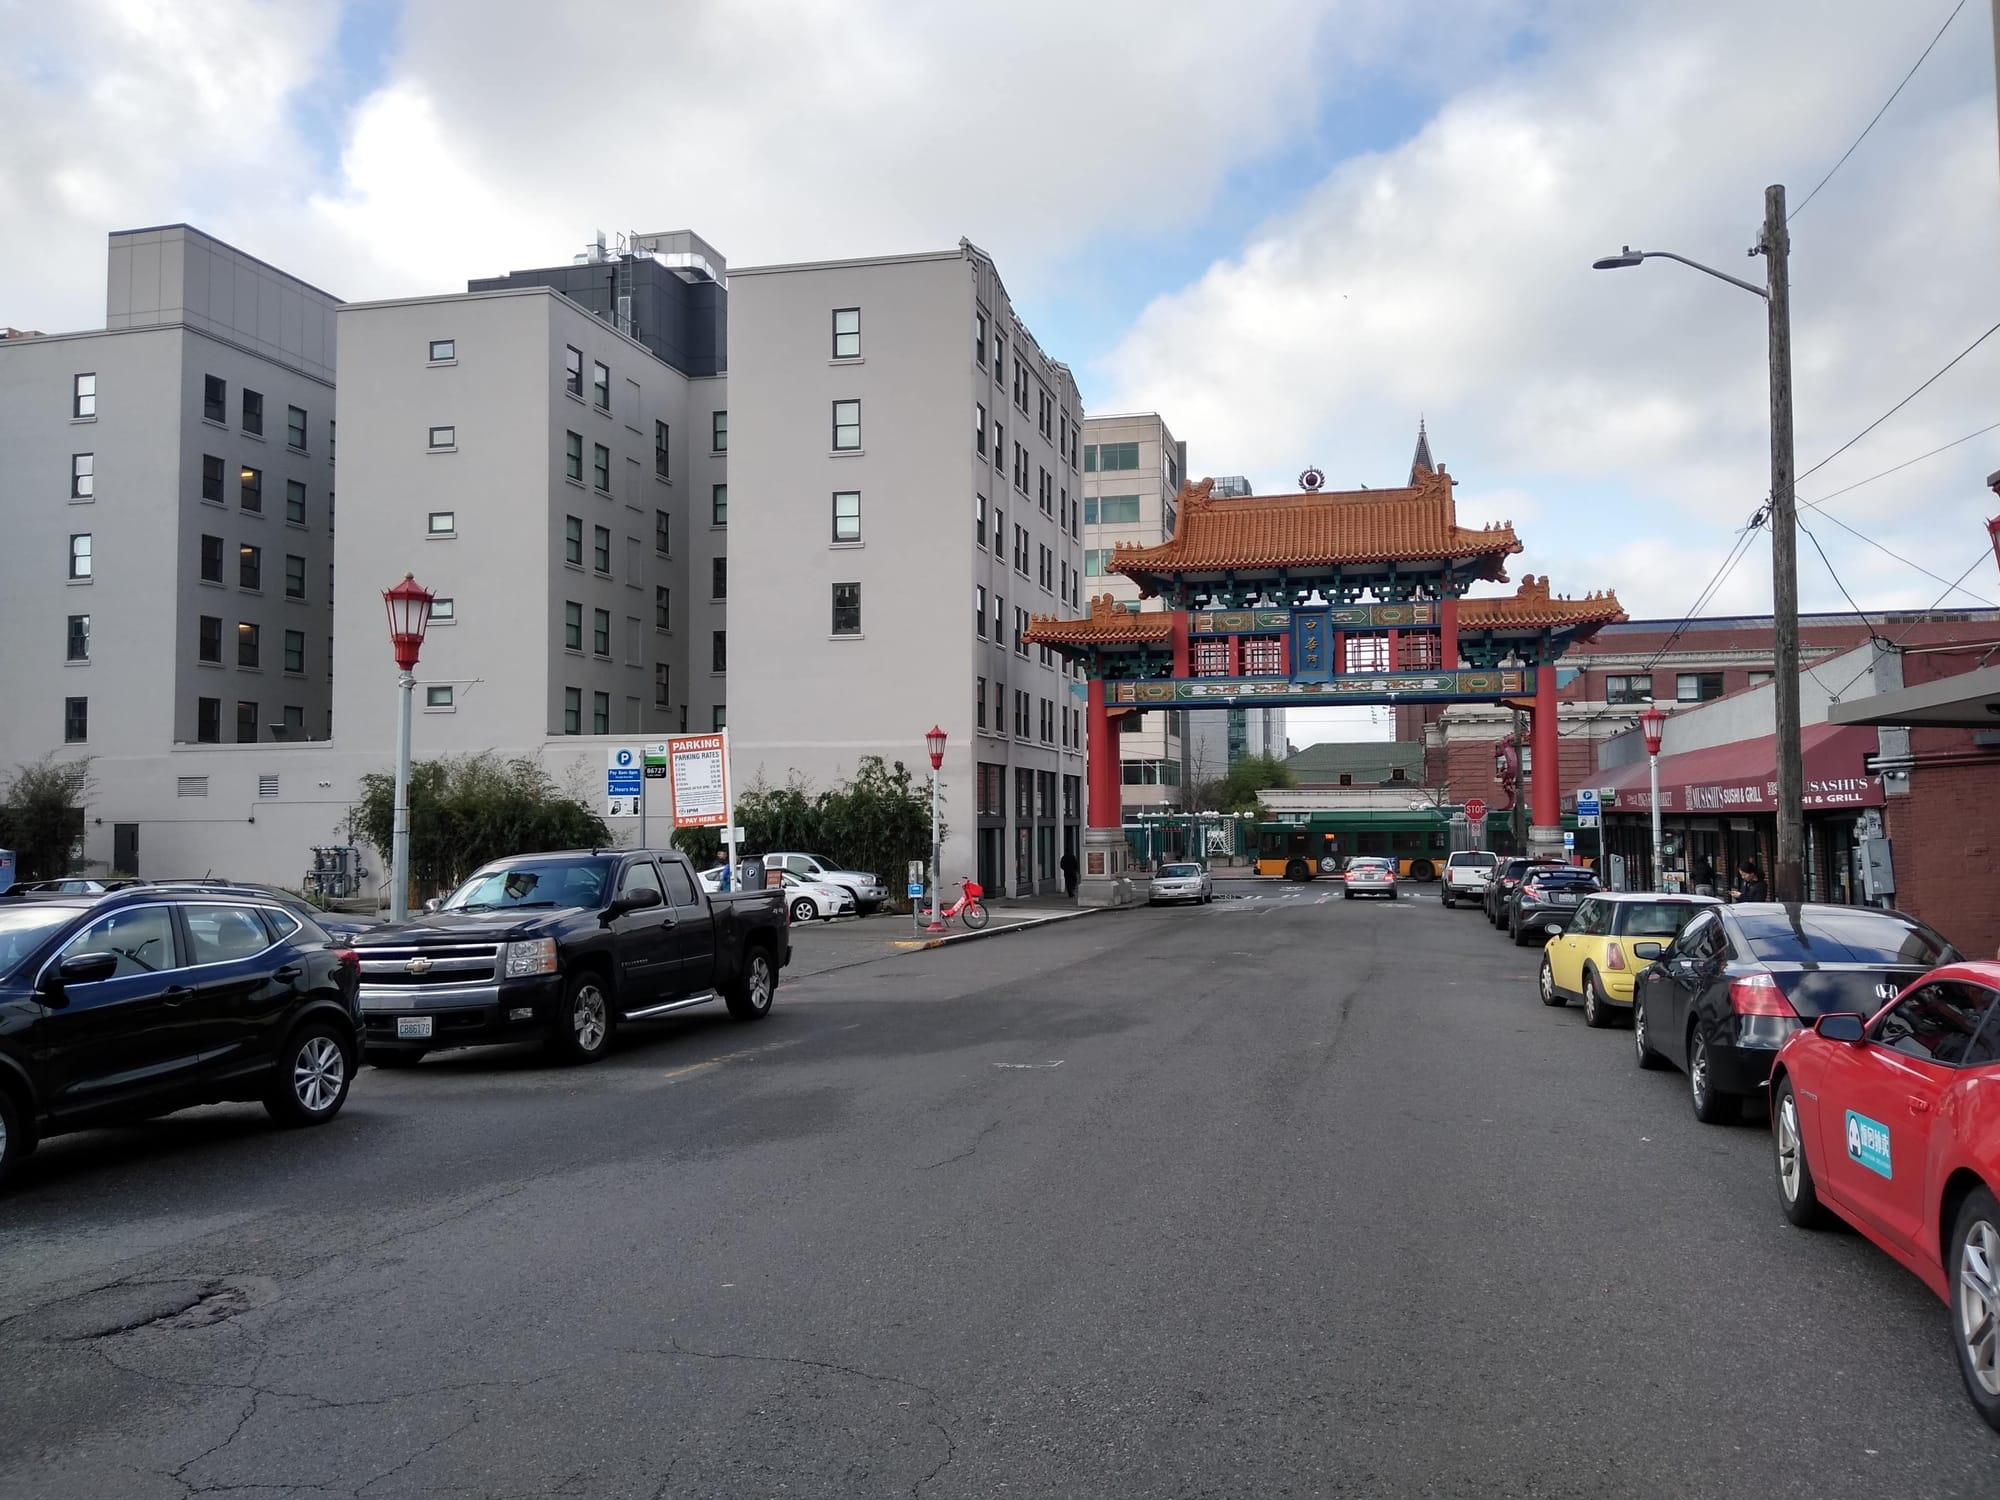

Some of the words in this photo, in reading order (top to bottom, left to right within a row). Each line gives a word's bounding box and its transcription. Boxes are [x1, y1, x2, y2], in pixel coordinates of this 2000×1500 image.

[672, 739, 720, 751] PARKING
[674, 753, 700, 761] PARKING
[609, 785, 615, 793] 2
[1692, 786, 1723, 809] MUSASHI'S
[1724, 788, 1741, 804] SUSHI
[1745, 785, 1763, 803] GRILL
[1826, 793, 1863, 803] GRILL
[699, 815, 716, 823] HERE
